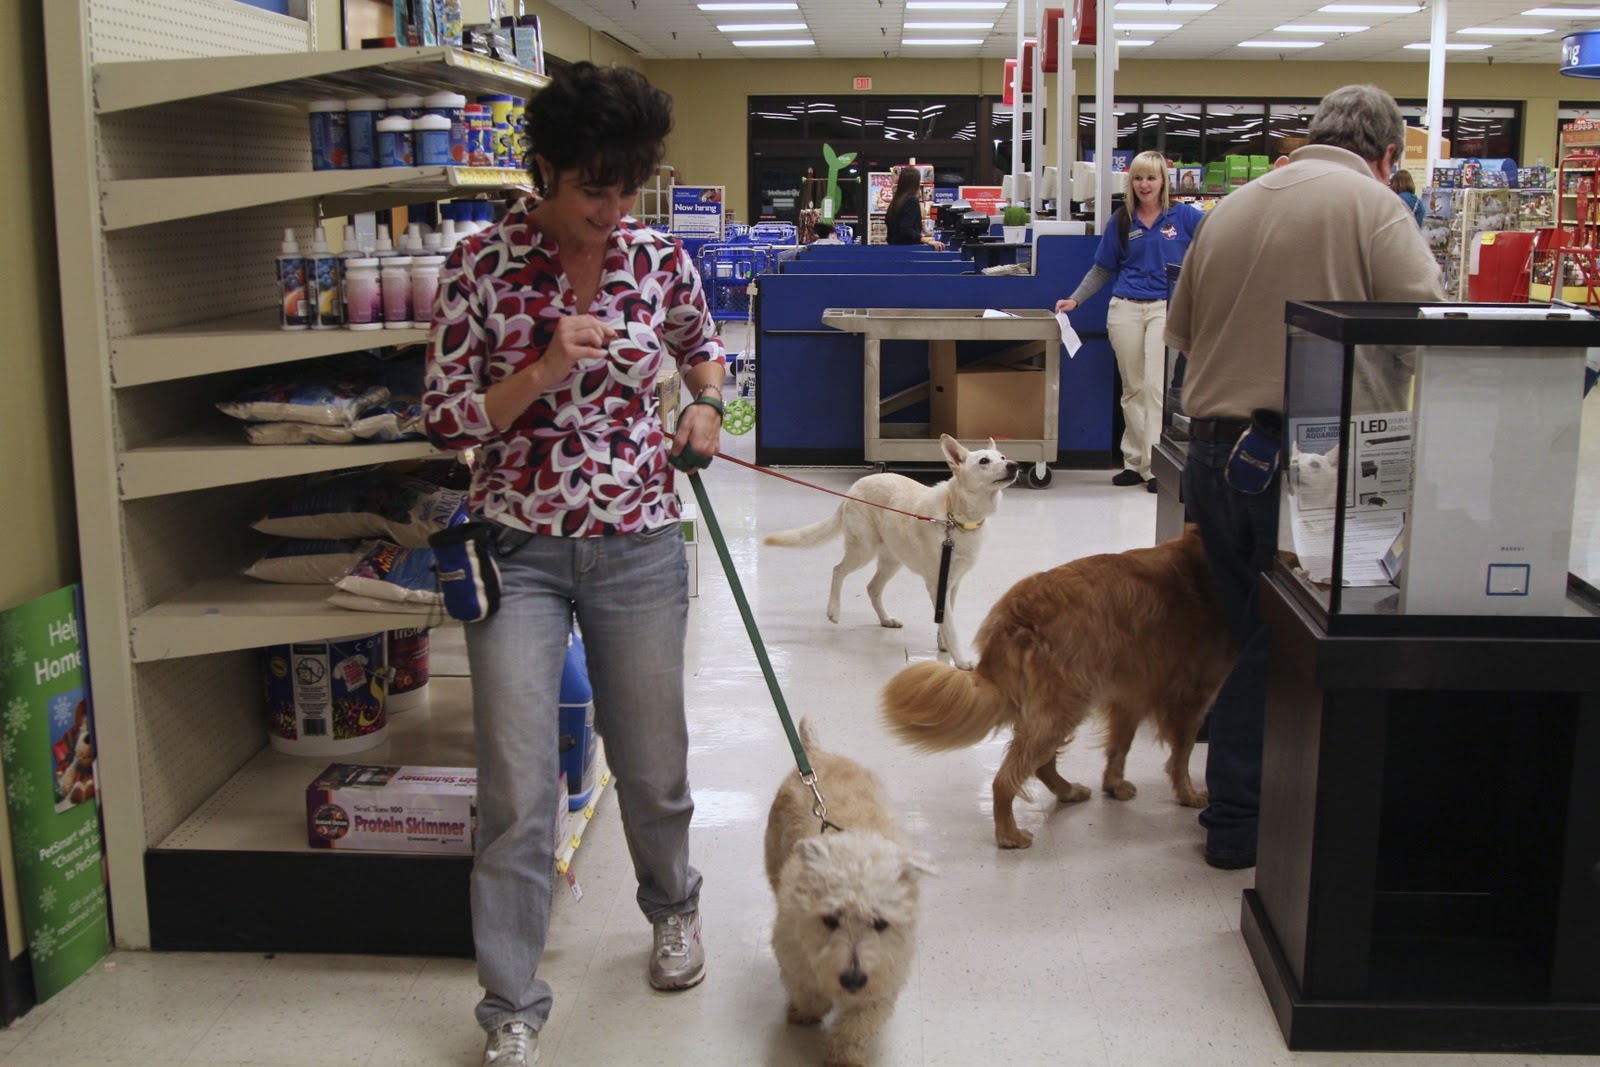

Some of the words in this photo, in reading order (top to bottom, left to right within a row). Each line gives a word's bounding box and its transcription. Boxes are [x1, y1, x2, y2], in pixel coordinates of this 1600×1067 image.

[856, 78, 870, 89] EXIT
[674, 203, 694, 211] Now
[694, 204, 717, 213] hiring
[1360, 419, 1388, 434] LED
[1306, 431, 1341, 440] AQUARIU
[354, 815, 404, 833] Protein
[406, 817, 465, 835] Skimmer
